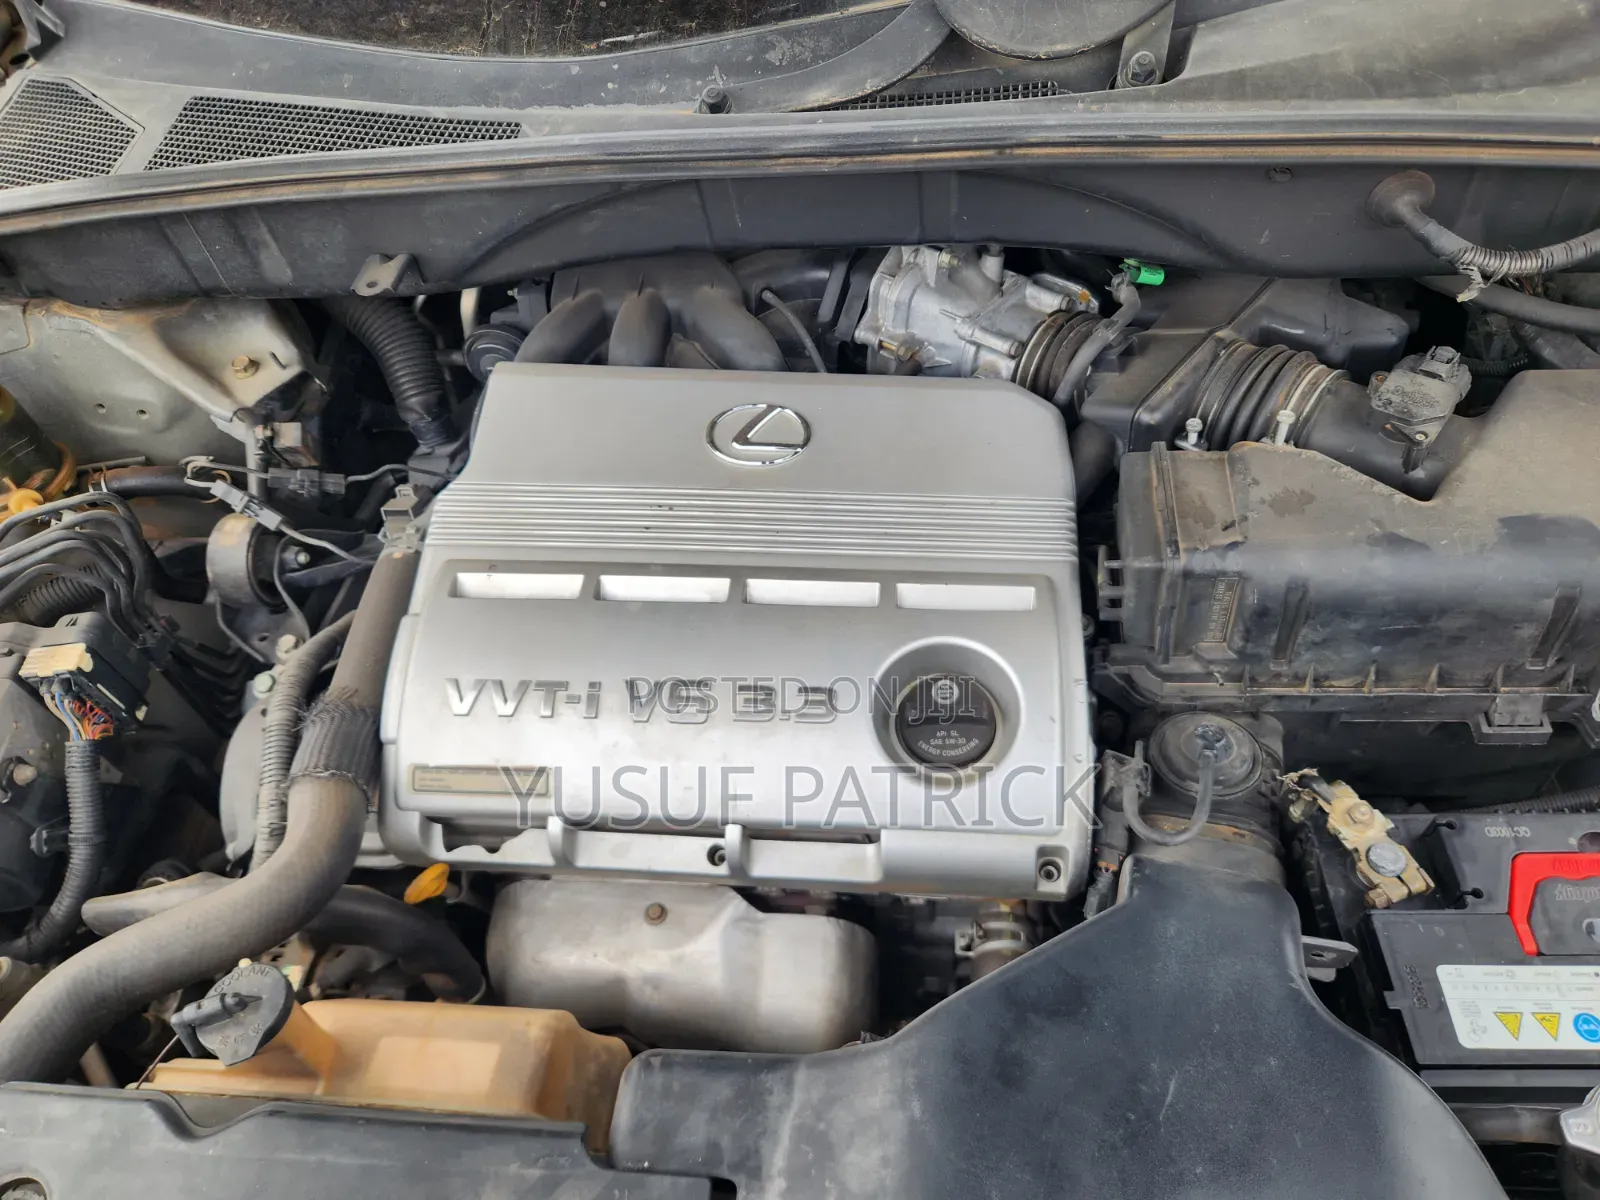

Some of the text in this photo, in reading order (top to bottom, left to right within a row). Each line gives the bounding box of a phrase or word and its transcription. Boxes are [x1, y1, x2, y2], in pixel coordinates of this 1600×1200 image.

[445, 678, 602, 719] VVT-i
[945, 737, 966, 745] 5W-30
[950, 729, 959, 737] SL
[917, 737, 979, 756] ENERGY CONSERVING
[214, 965, 274, 993] COOLANT
